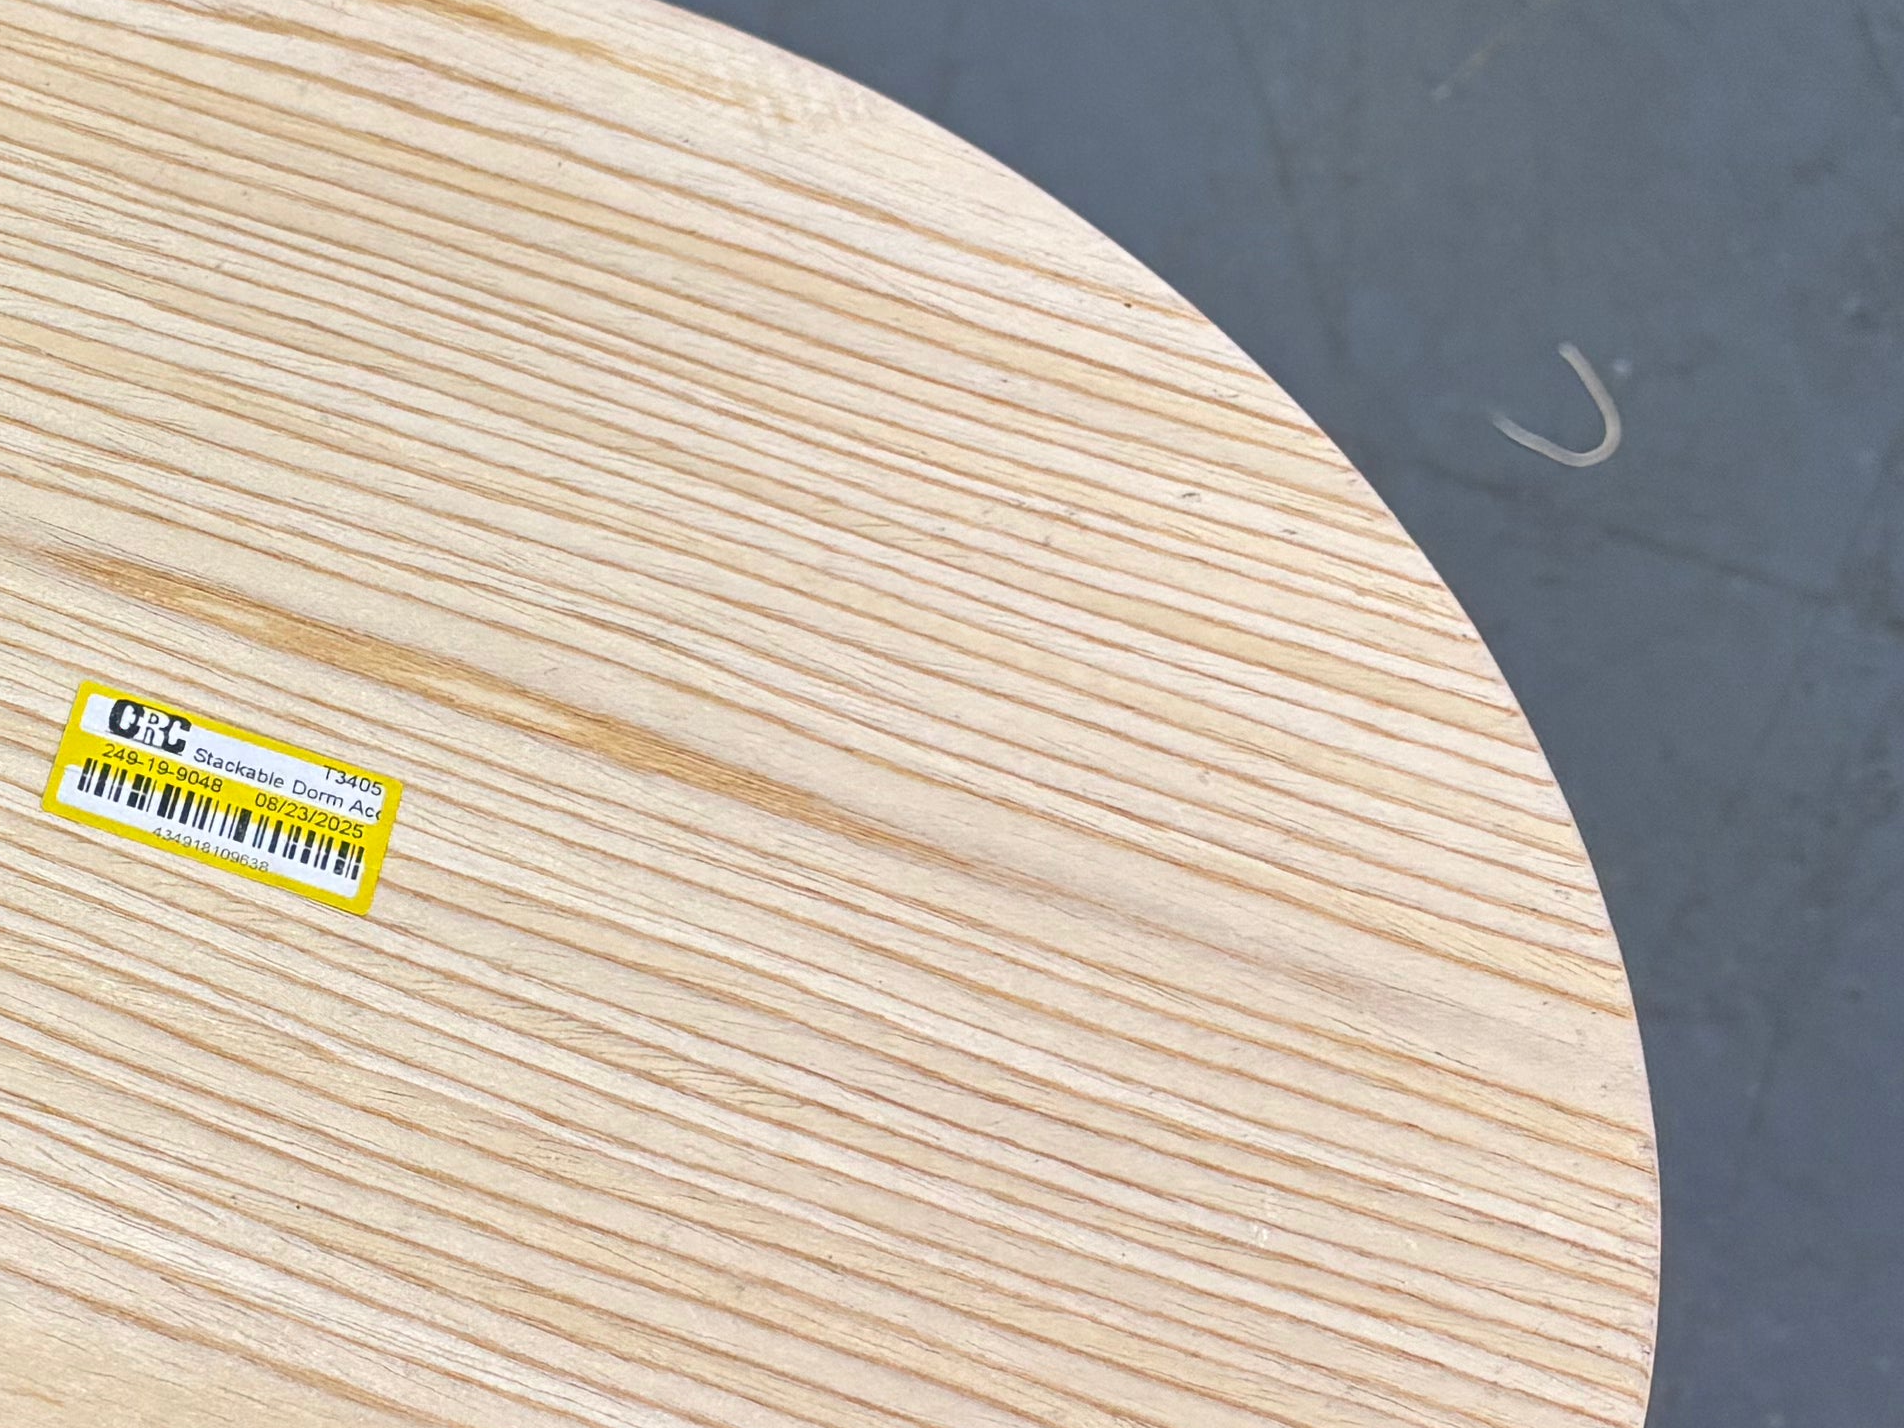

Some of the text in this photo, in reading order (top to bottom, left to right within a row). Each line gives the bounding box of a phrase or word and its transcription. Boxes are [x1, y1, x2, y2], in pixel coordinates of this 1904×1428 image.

[102, 743, 364, 839] 249-19-9048 08/23/2025
[193, 747, 284, 788] Stackable
[292, 779, 344, 807] Dorm
[323, 764, 383, 797] T3405
